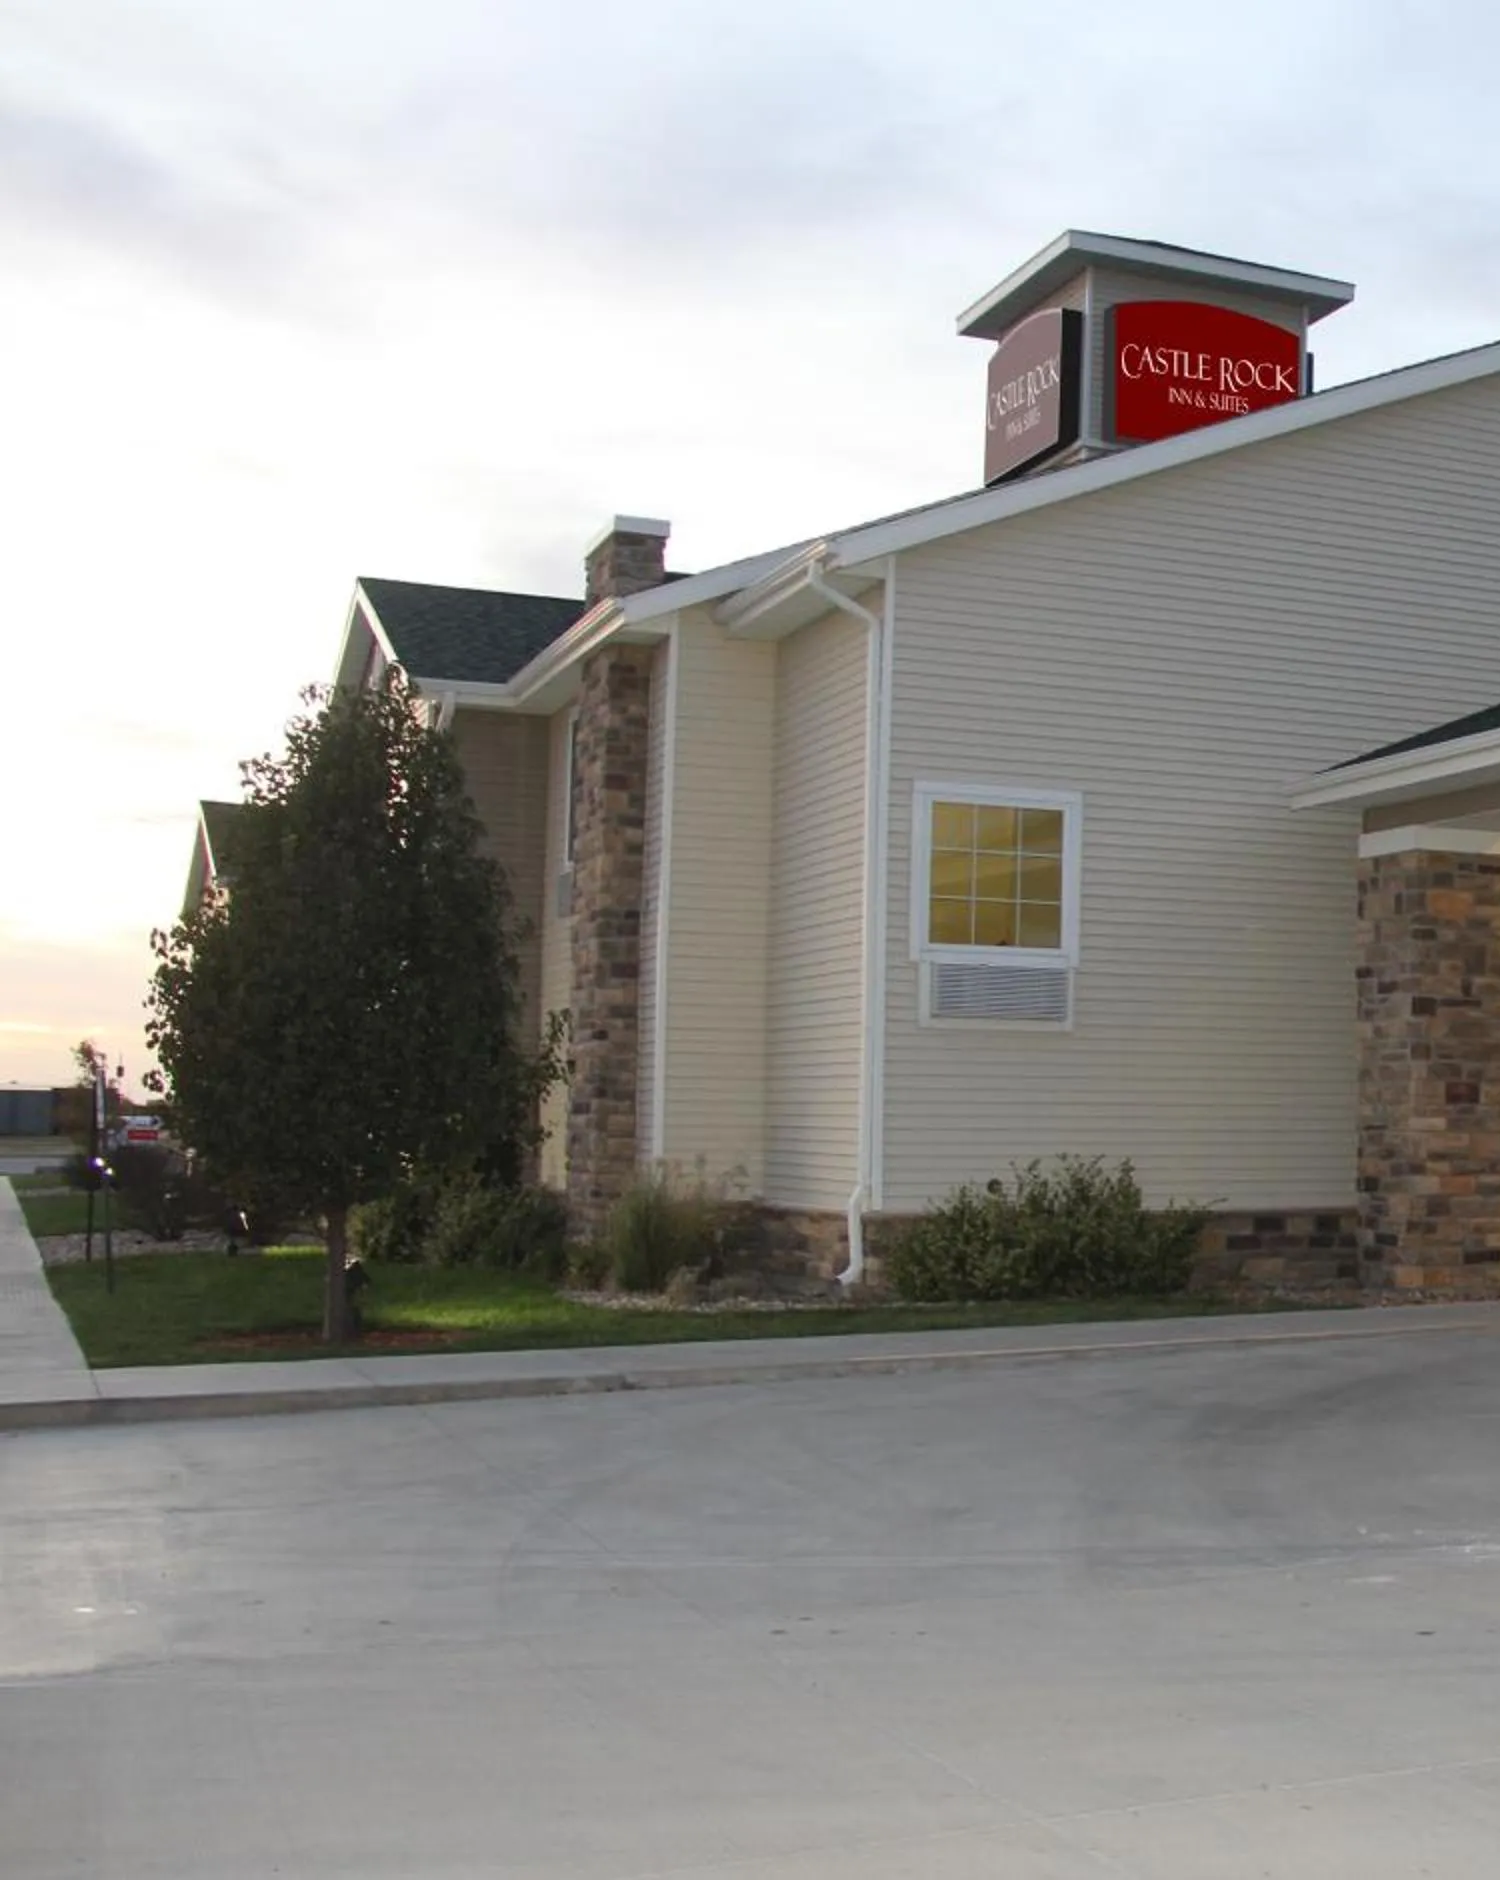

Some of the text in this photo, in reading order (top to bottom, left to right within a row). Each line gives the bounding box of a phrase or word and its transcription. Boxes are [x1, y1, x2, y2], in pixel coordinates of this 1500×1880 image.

[1121, 343, 1296, 393] CASTLE ROCK
[1168, 386, 1249, 415] INN & SUITES
